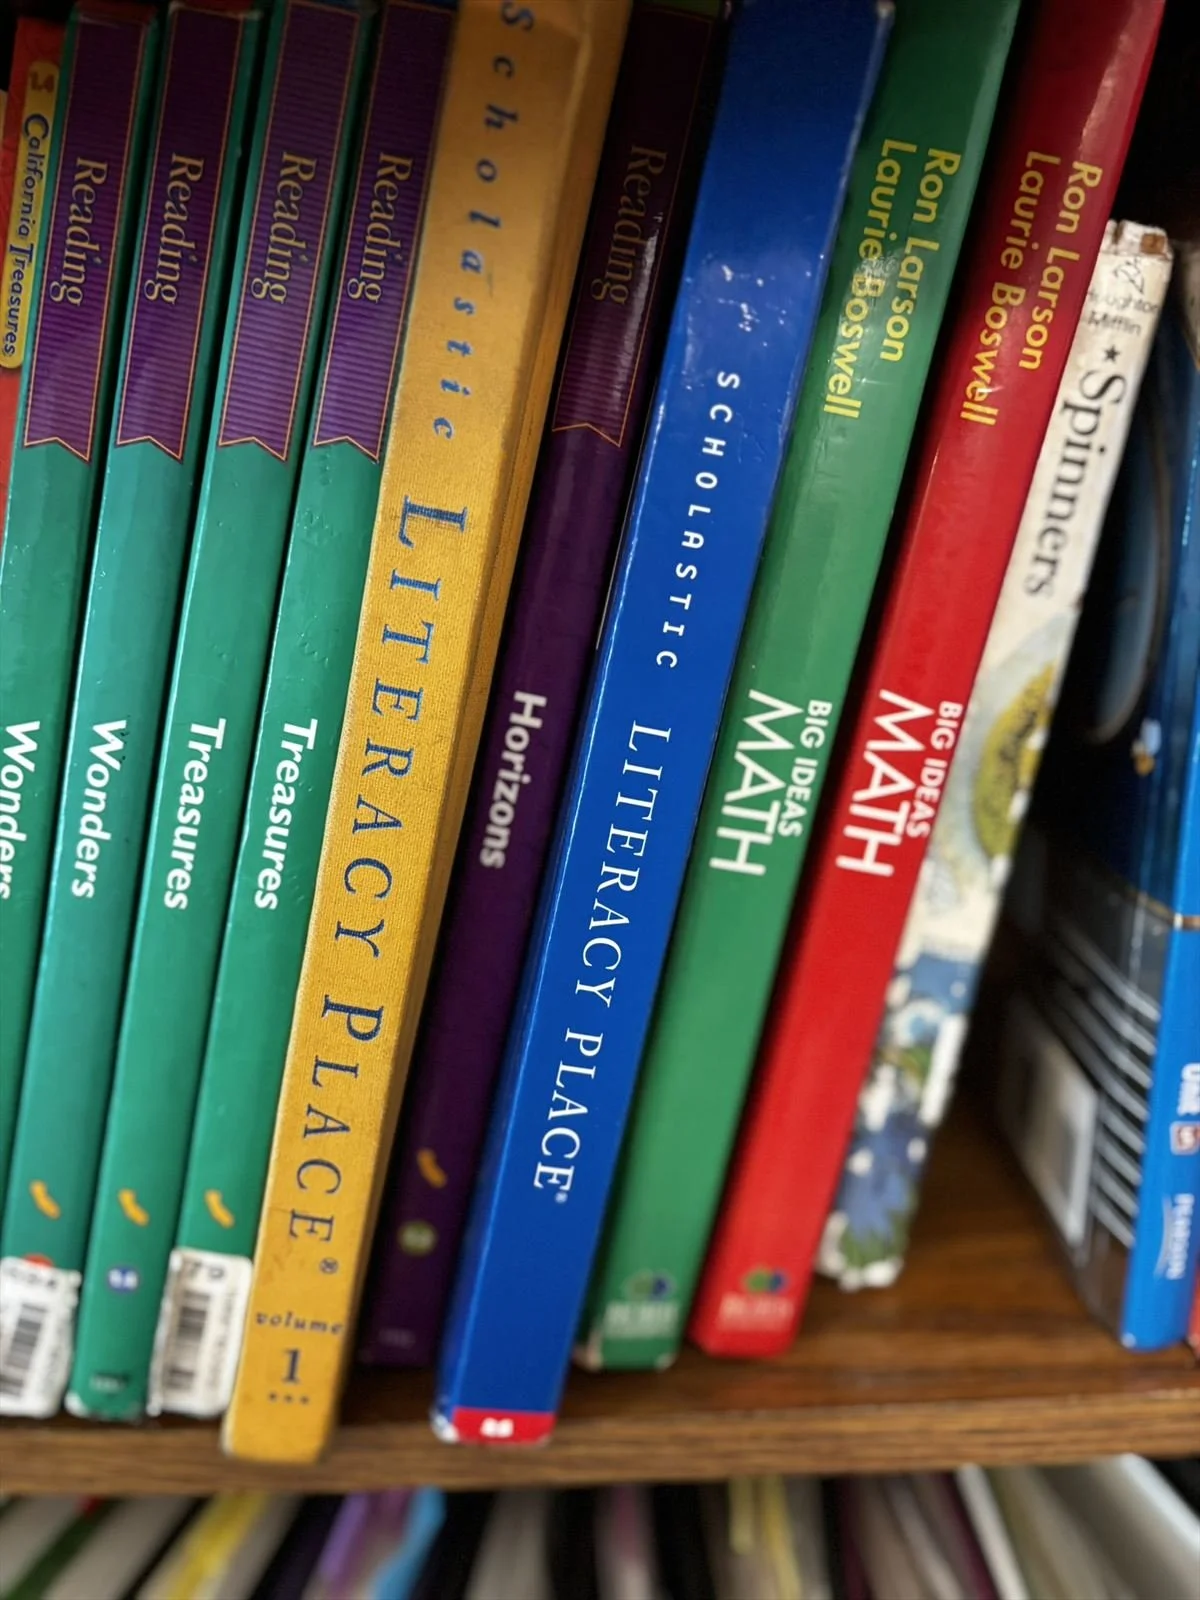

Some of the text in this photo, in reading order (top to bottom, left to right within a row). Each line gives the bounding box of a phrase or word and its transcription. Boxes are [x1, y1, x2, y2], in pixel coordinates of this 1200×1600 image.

[3, 113, 49, 357] California Treasures
[49, 157, 108, 306] Reading
[144, 153, 205, 305] Reading
[250, 151, 317, 304] Reading
[347, 152, 414, 304] Reading
[433, 0, 534, 440] Scholastic
[590, 144, 668, 304] Reading
[823, 139, 917, 418] Laurie Boswell
[880, 147, 961, 361] Ron Larson
[960, 151, 1061, 426] Laurie Boswell
[1019, 160, 1103, 370] Ron Larson
[656, 371, 741, 668] SCHOLASTIC
[1024, 370, 1127, 598] Spinners
[71, 719, 127, 898] Wonders
[164, 718, 226, 910] Treasures
[255, 718, 318, 911] Treasures
[335, 495, 468, 958] LITERACY
[480, 691, 547, 869] Horizons
[709, 688, 803, 876] MATH
[777, 698, 832, 837] BIG IDEAS
[836, 688, 935, 878] MATH
[905, 700, 963, 839] BIG IDEAS
[575, 720, 671, 1008] LITERACY
[255, 1311, 344, 1335] volume
[282, 1348, 301, 1384] 1
